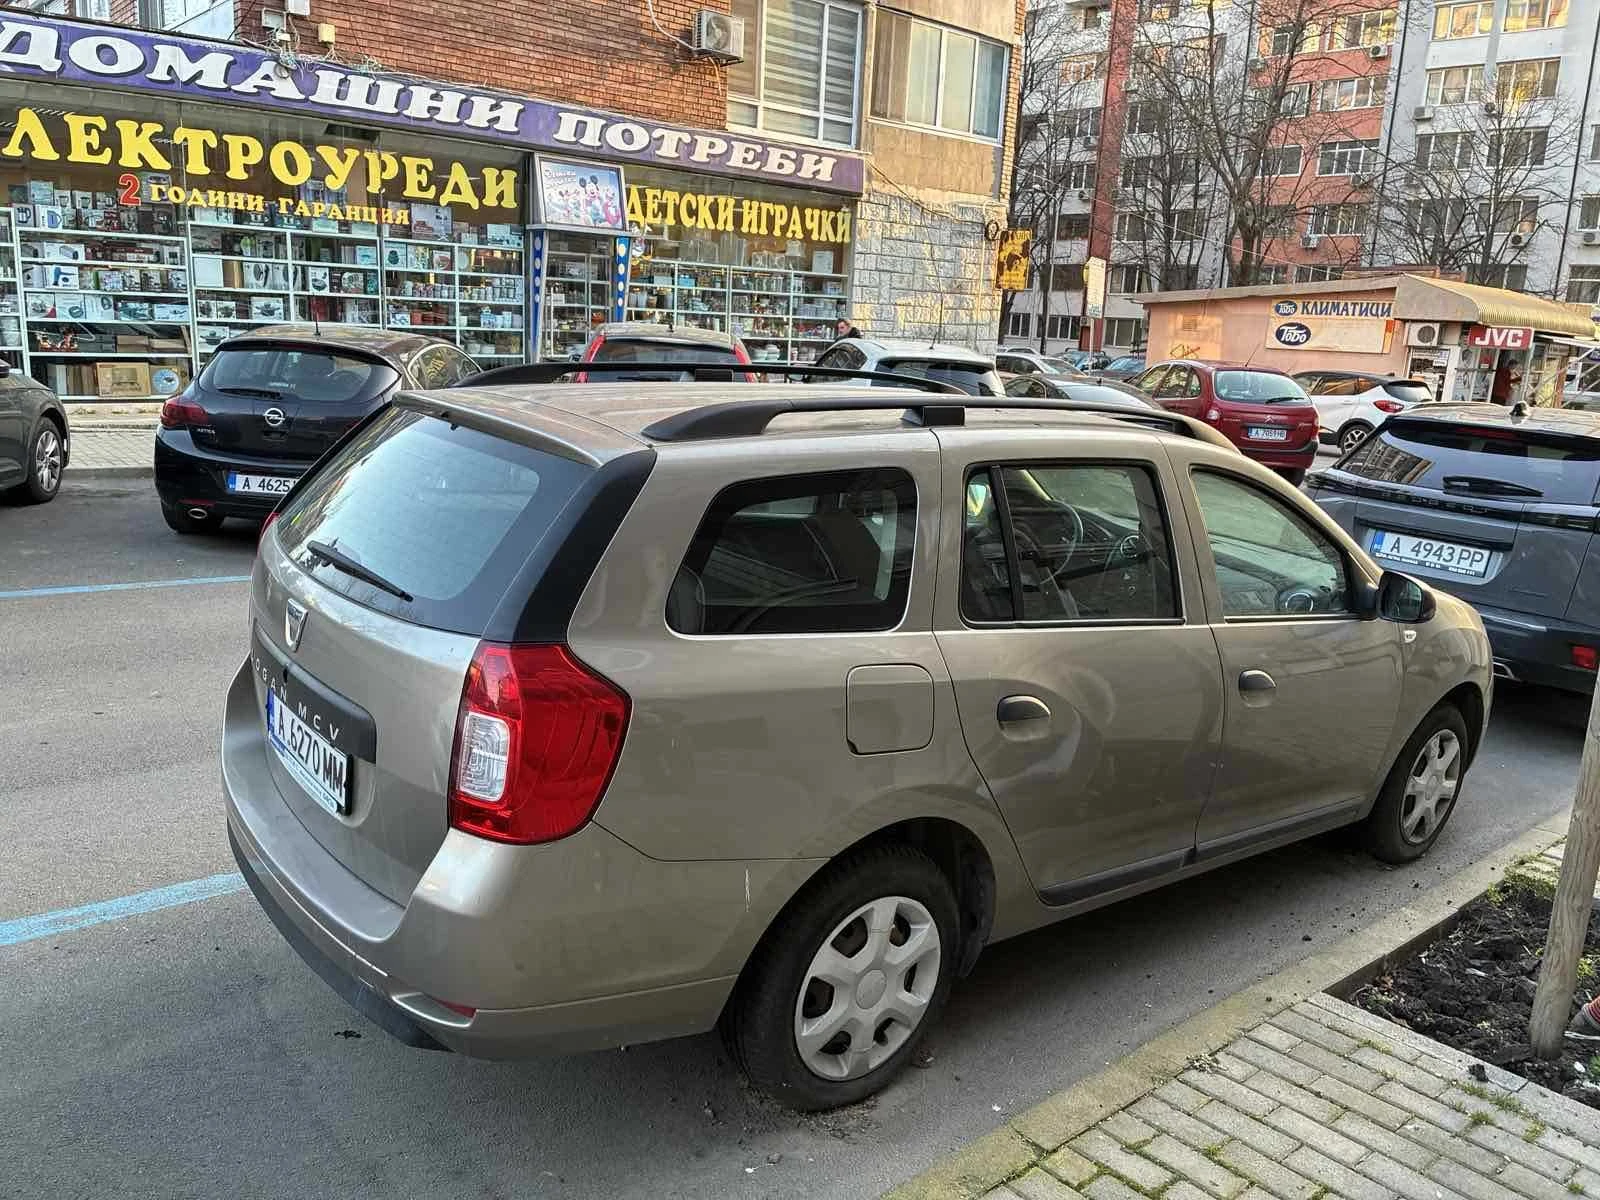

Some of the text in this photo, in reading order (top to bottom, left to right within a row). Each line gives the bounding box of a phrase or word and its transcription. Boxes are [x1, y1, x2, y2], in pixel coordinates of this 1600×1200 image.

[0, 20, 838, 182] ДОМАШНИ ПОТРЕБИ
[2, 107, 518, 210] ЛЕКТРОУРЕДИ
[118, 173, 410, 226] 2 ГОДИНИ ГАРАНЦИЯ
[626, 184, 851, 243] ДЕТСКИ ИГРАЧКИ
[1301, 301, 1393, 318] КЛИМАТИЦИ
[1474, 328, 1524, 347] JVC
[242, 477, 296, 492] A 4625
[1390, 537, 1400, 554] A
[278, 704, 285, 741] A
[298, 702, 339, 741] MCV
